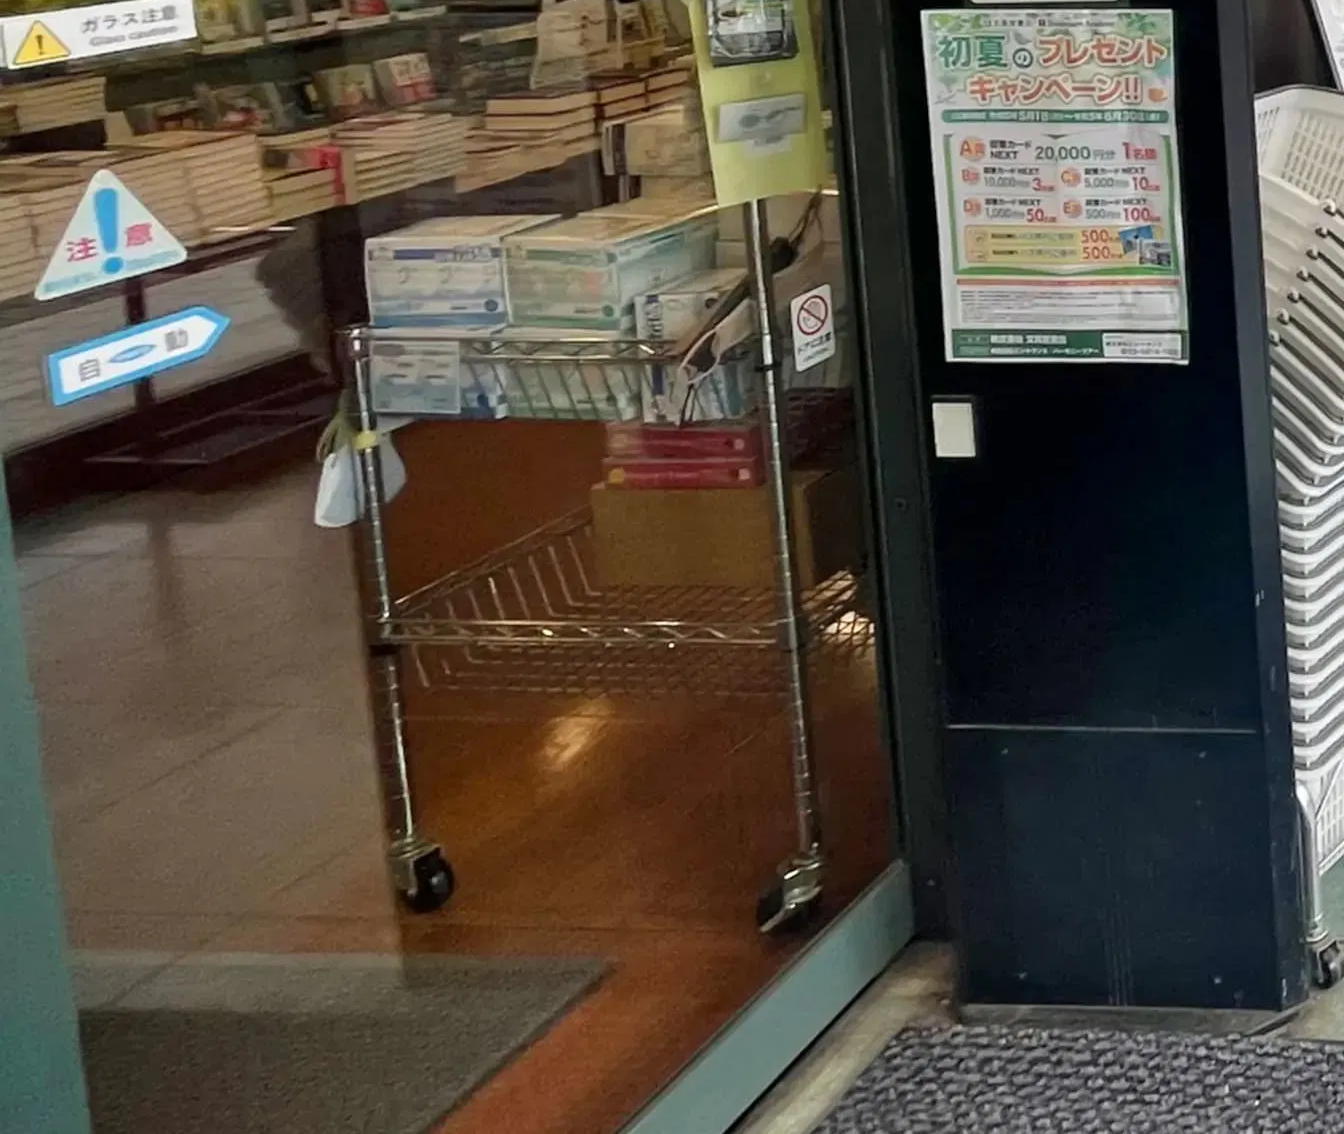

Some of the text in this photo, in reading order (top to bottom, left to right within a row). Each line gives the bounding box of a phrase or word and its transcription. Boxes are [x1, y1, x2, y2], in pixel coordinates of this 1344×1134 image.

[81, 4, 177, 34] ガラス注意
[938, 34, 1167, 69] 初夏のプレゼント
[968, 73, 1142, 105] キャンペーン!!
